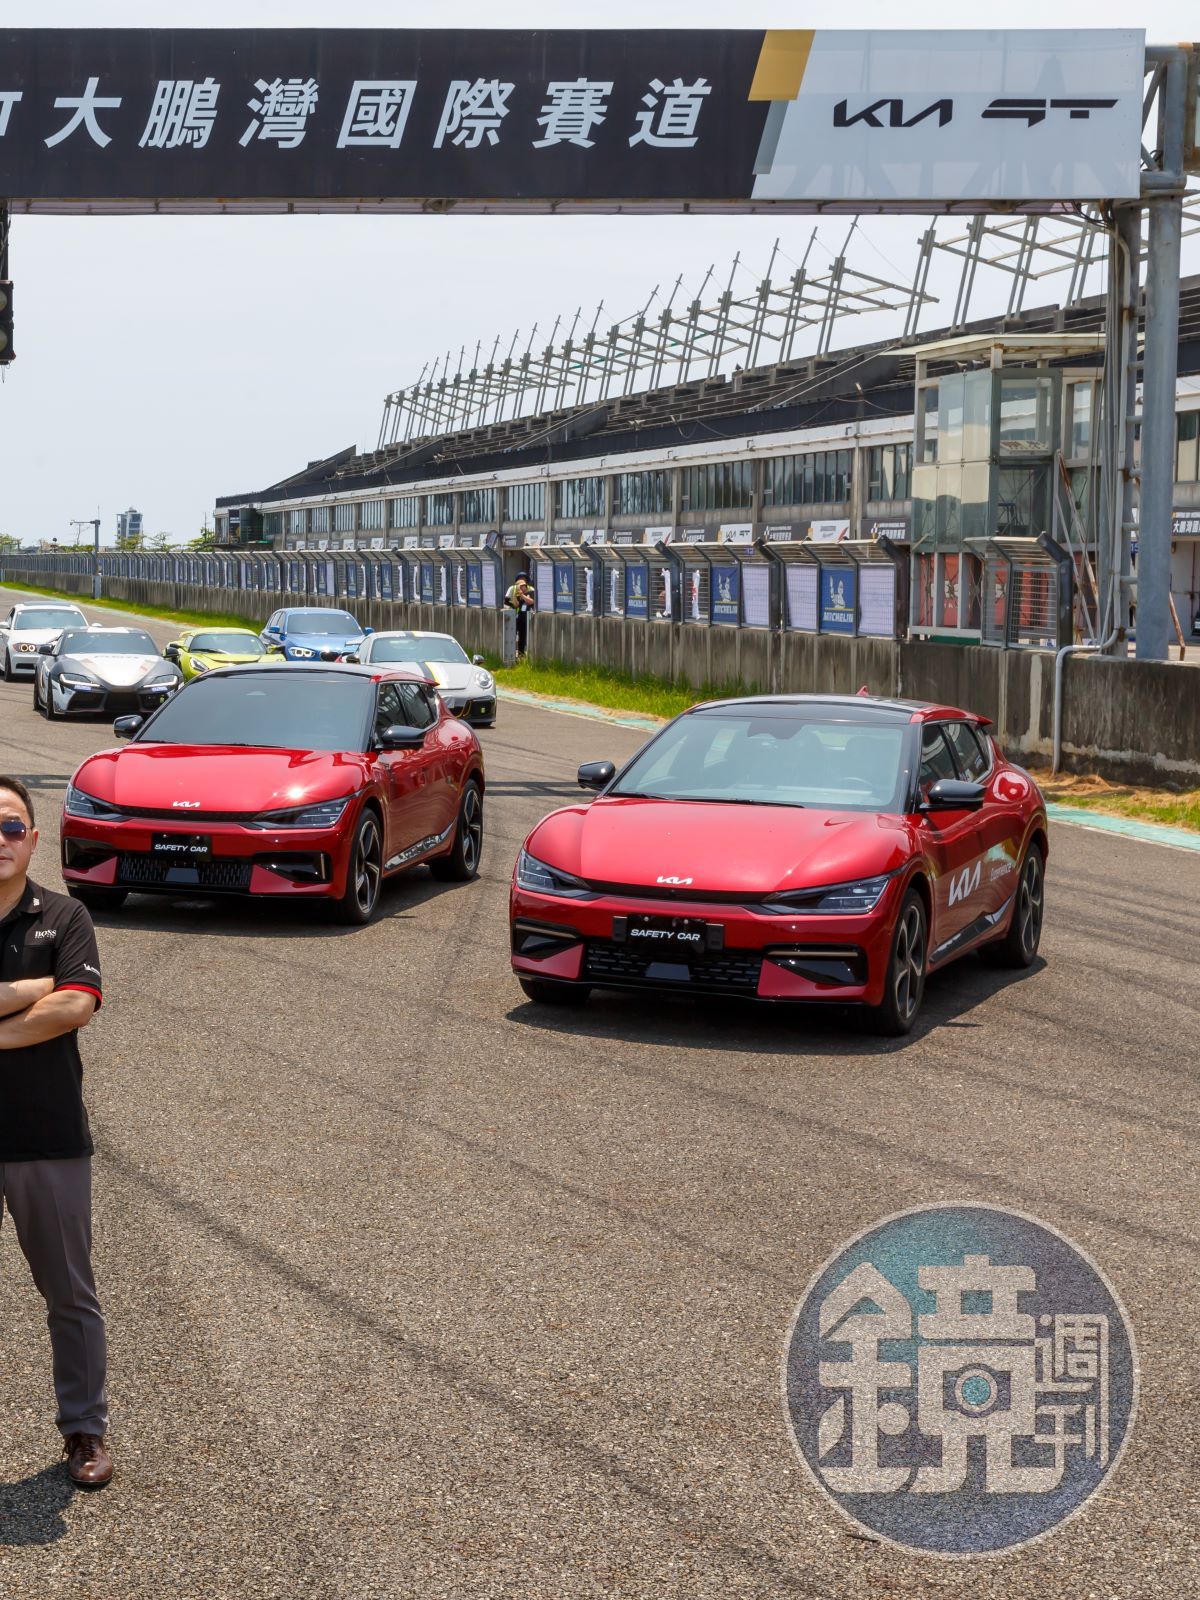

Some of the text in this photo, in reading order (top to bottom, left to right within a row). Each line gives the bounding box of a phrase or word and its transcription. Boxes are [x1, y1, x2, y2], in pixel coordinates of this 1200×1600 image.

[43, 77, 712, 149] 大鵬灣國際賽道
[833, 99, 953, 128] KIA
[822, 611, 855, 623] MICHELIN
[656, 875, 693, 885] KIA
[948, 860, 982, 907] KIA
[34, 929, 57, 937] BOSS
[630, 928, 701, 941] SAFETY CAR
